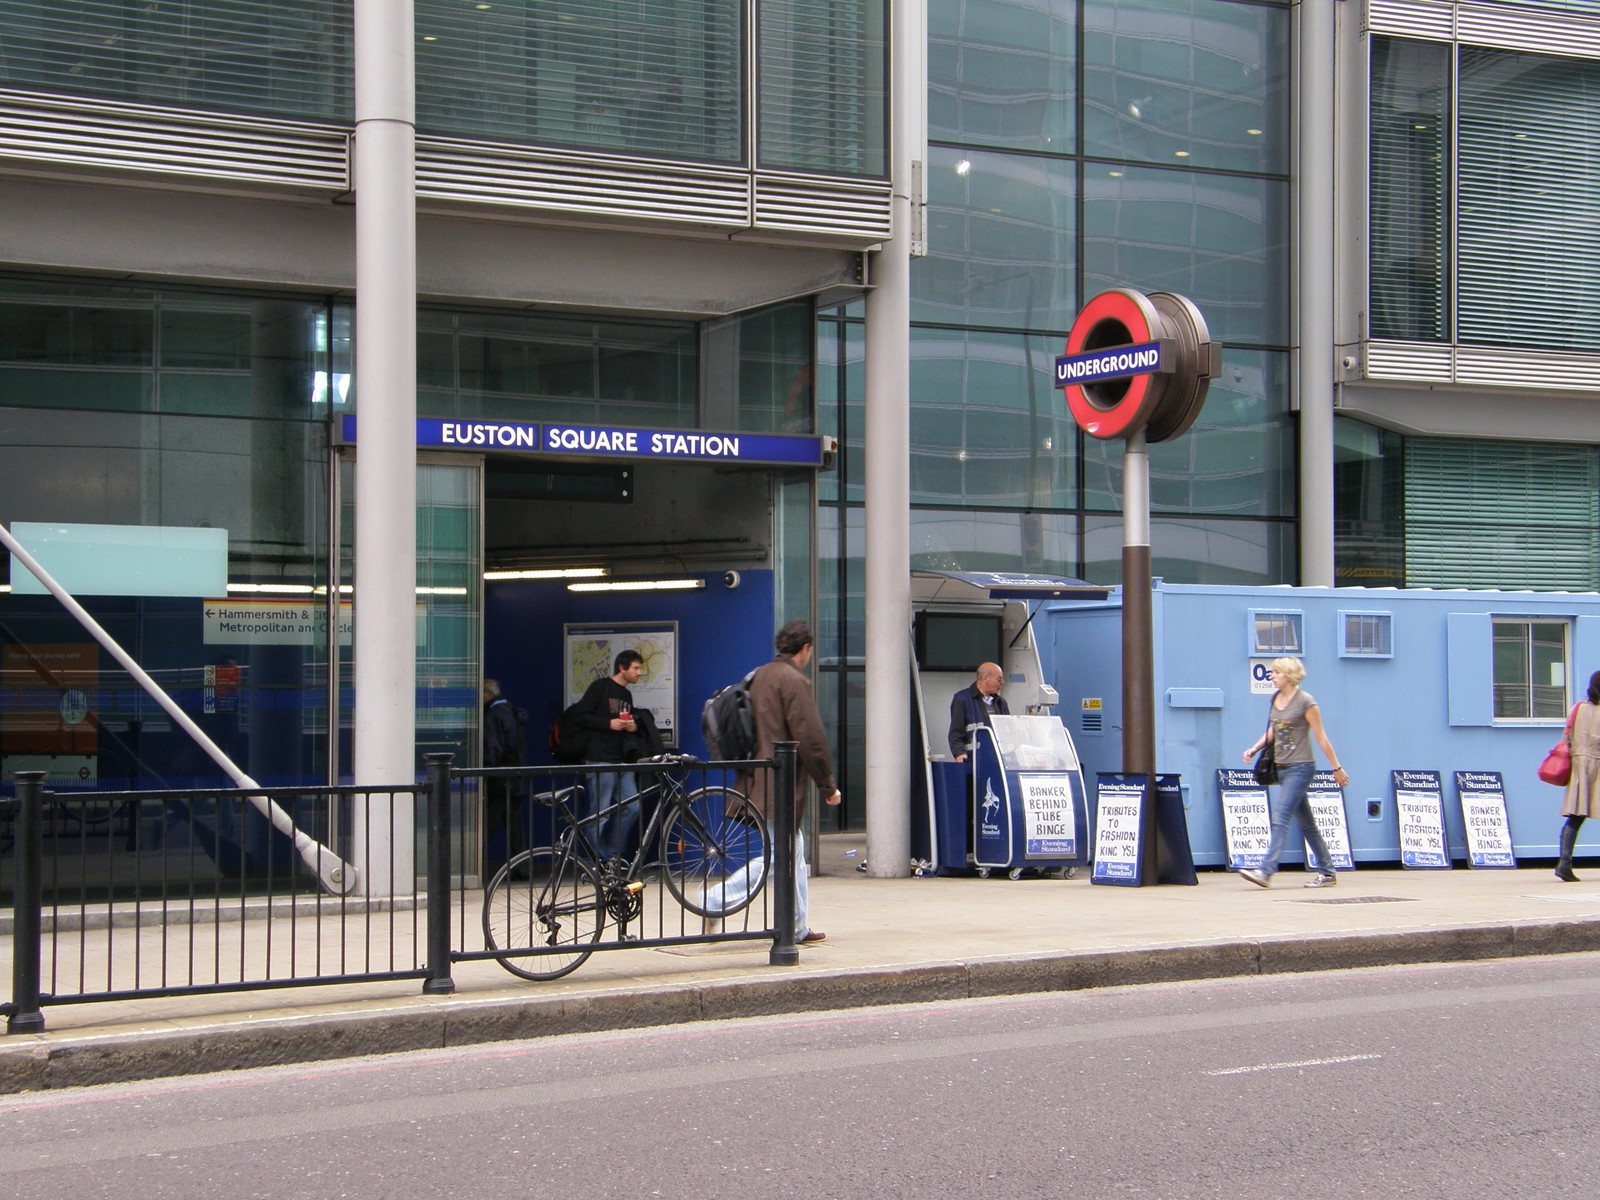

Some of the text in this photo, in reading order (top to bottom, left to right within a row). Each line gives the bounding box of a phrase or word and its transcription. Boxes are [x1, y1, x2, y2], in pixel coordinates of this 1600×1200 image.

[1058, 349, 1158, 379] UNDERGROUND
[442, 423, 739, 457] EUSTON SQUARE STATION
[218, 609, 298, 620] Hammersmith
[301, 610, 309, 620] &
[219, 622, 294, 635] Metropolitan
[1313, 772, 1335, 781] ening
[1403, 772, 1434, 781] Evening
[1465, 773, 1496, 782] Evening
[1098, 783, 1145, 791] Evening Standard
[1403, 780, 1439, 789] Standard
[1466, 781, 1501, 789] Standard
[1030, 786, 1066, 797] BANKER
[1029, 799, 1067, 810] BEHIND
[1228, 805, 1266, 814] TRIBUTES
[1401, 803, 1438, 814] TRIBUTES
[1102, 806, 1138, 817] TRIBUTES
[1312, 805, 1339, 816] ANKER
[1470, 806, 1501, 815] BANKER
[1035, 811, 1061, 822] TUBE
[1237, 816, 1249, 825] TO
[1410, 815, 1421, 823] TO
[1108, 819, 1119, 829] TO
[1470, 817, 1502, 827] BEHIND
[1036, 824, 1066, 836] BINGE
[1231, 826, 1269, 837] FASHION
[1404, 824, 1440, 835] FASHION
[1475, 828, 1498, 837] TUBE
[1100, 830, 1137, 841] FASHION
[1041, 840, 1068, 848] Evening
[1233, 840, 1252, 850] KING
[1405, 838, 1442, 848] KING YSL
[1477, 840, 1503, 849] BINGE
[1100, 846, 1137, 857] KING YSL
[1107, 863, 1130, 871] Evening
[1106, 869, 1132, 877] Standard
